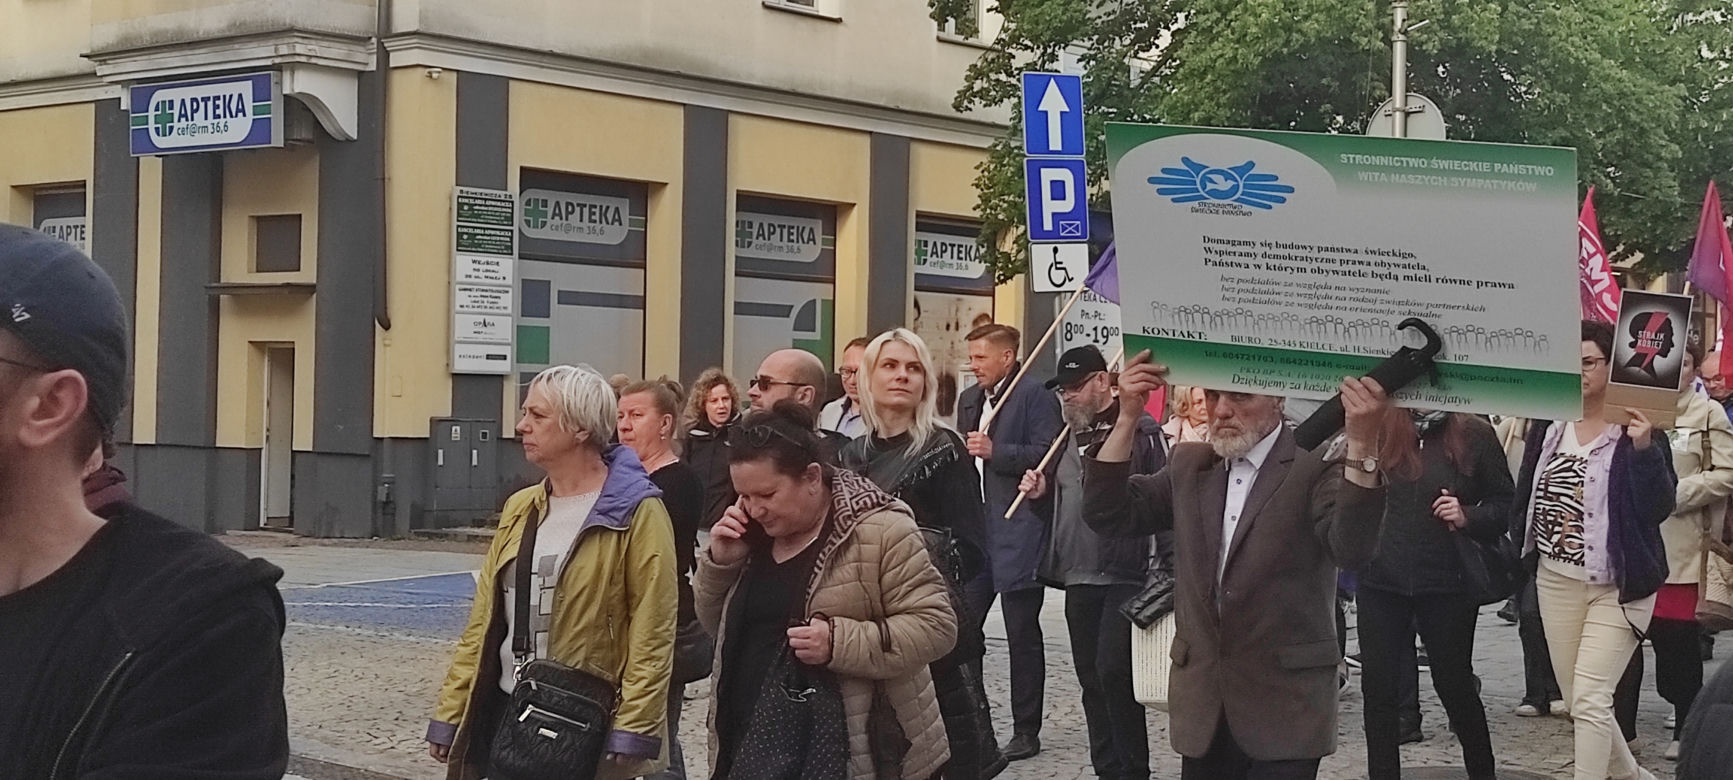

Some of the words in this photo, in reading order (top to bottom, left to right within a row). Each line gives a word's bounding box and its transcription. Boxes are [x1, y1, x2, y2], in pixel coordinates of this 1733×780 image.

[178, 93, 246, 122] APTEKA
[177, 122, 208, 137] cef@rm
[210, 121, 229, 136] 36,6
[1340, 154, 1428, 168] STRONNICTWO
[1430, 156, 1490, 172] ŚWIECKIE
[1494, 161, 1554, 176] PAŃSTWO
[1358, 171, 1388, 183] WITA
[1391, 174, 1447, 186] NASZYCH
[1450, 177, 1537, 192] SYMPATYKÓW
[1040, 168, 1076, 231] P
[551, 200, 623, 226] APTEKA
[550, 222, 584, 234] cef@rm
[586, 226, 605, 237] 36,6
[756, 222, 816, 246] APTEKA
[1202, 236, 1256, 249] Domagamy
[1260, 240, 1272, 250] się
[1275, 241, 1314, 253] budowy
[1317, 245, 1358, 255] państwa
[1203, 246, 1258, 260] Wspieramy
[1262, 252, 1336, 265] demokratyczne
[1340, 258, 1372, 268] prawa
[1204, 258, 1250, 270] Państwa
[1266, 262, 1307, 275] którym
[1310, 266, 1368, 278] obywatele
[1371, 270, 1398, 282] będą
[1402, 274, 1432, 283] mieli
[1436, 276, 1473, 286] równe
[1476, 280, 1515, 292] prawa
[1220, 274, 1234, 282] bez
[1296, 282, 1332, 292] względu
[1349, 286, 1391, 296] wyznanie
[1221, 284, 1235, 292] bez
[1296, 292, 1333, 301] względu
[1349, 294, 1377, 305] rodzaj
[1380, 298, 1424, 308] związków
[1426, 302, 1486, 312] partnerskich
[1222, 294, 1236, 302] bez
[1297, 301, 1334, 310] względu
[1398, 310, 1442, 320] seksualne
[1142, 326, 1208, 340] KONTAKT:
[1353, 345, 1396, 356] H.Sienkie
[1454, 354, 1469, 362] 107
[1638, 330, 1664, 341] STRAJK
[1638, 340, 1663, 349] KOBIET
[1232, 373, 1286, 391] Dziękujemy
[1290, 382, 1301, 390] za
[1304, 380, 1332, 392] każde
[1425, 392, 1472, 406] inicjatyw
